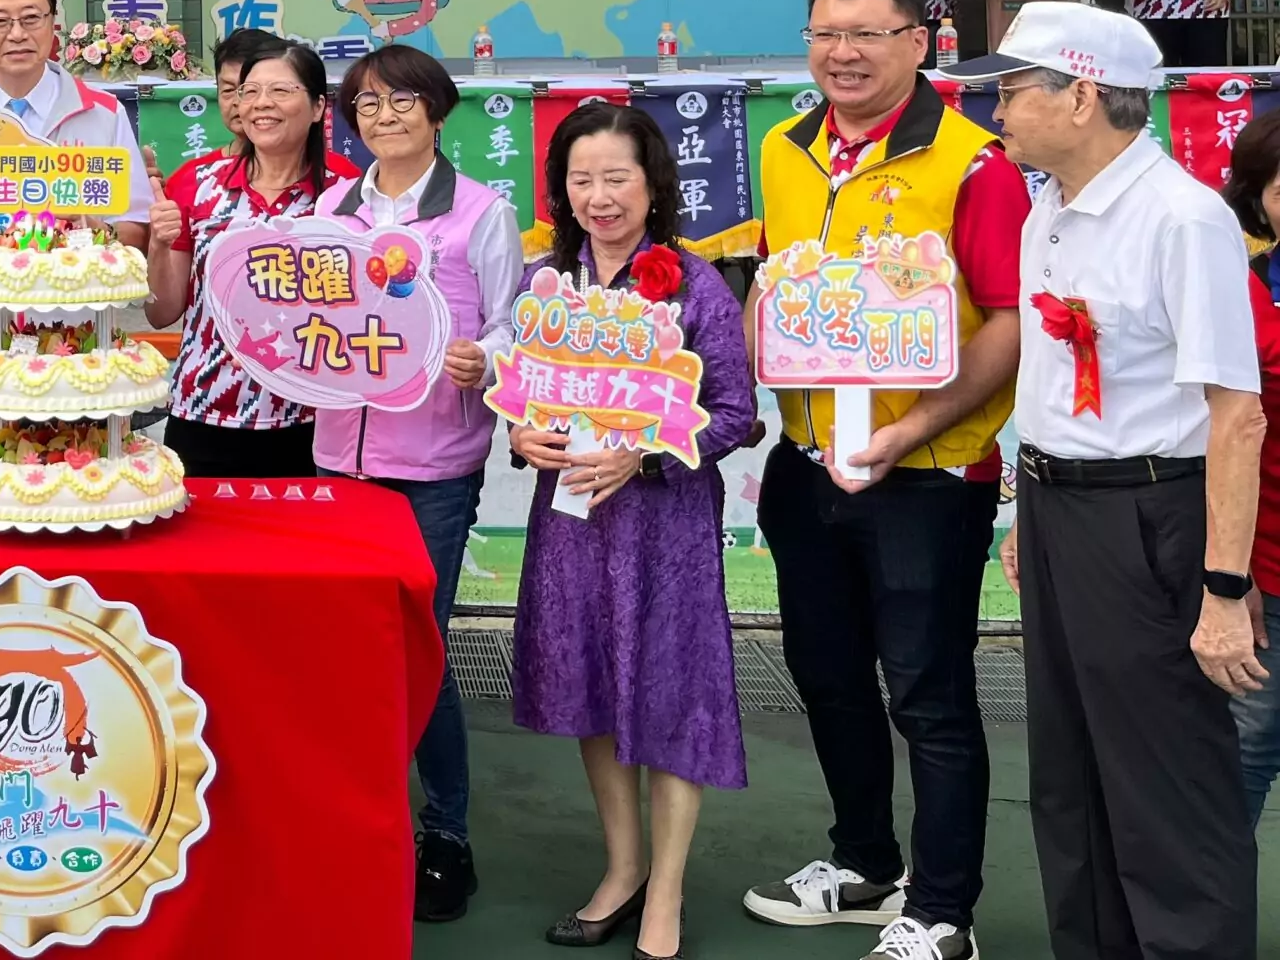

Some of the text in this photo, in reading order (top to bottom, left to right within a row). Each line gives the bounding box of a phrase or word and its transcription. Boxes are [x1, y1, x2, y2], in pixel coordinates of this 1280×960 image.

[677, 125, 713, 222] 亞軍
[247, 243, 355, 303] 飛躍
[293, 313, 404, 375] 九十
[513, 296, 653, 361] 90週年慶
[518, 355, 685, 415] 飛越九十
[9, 742, 63, 755] Dong Men
[65, 851, 100, 868] 合作
